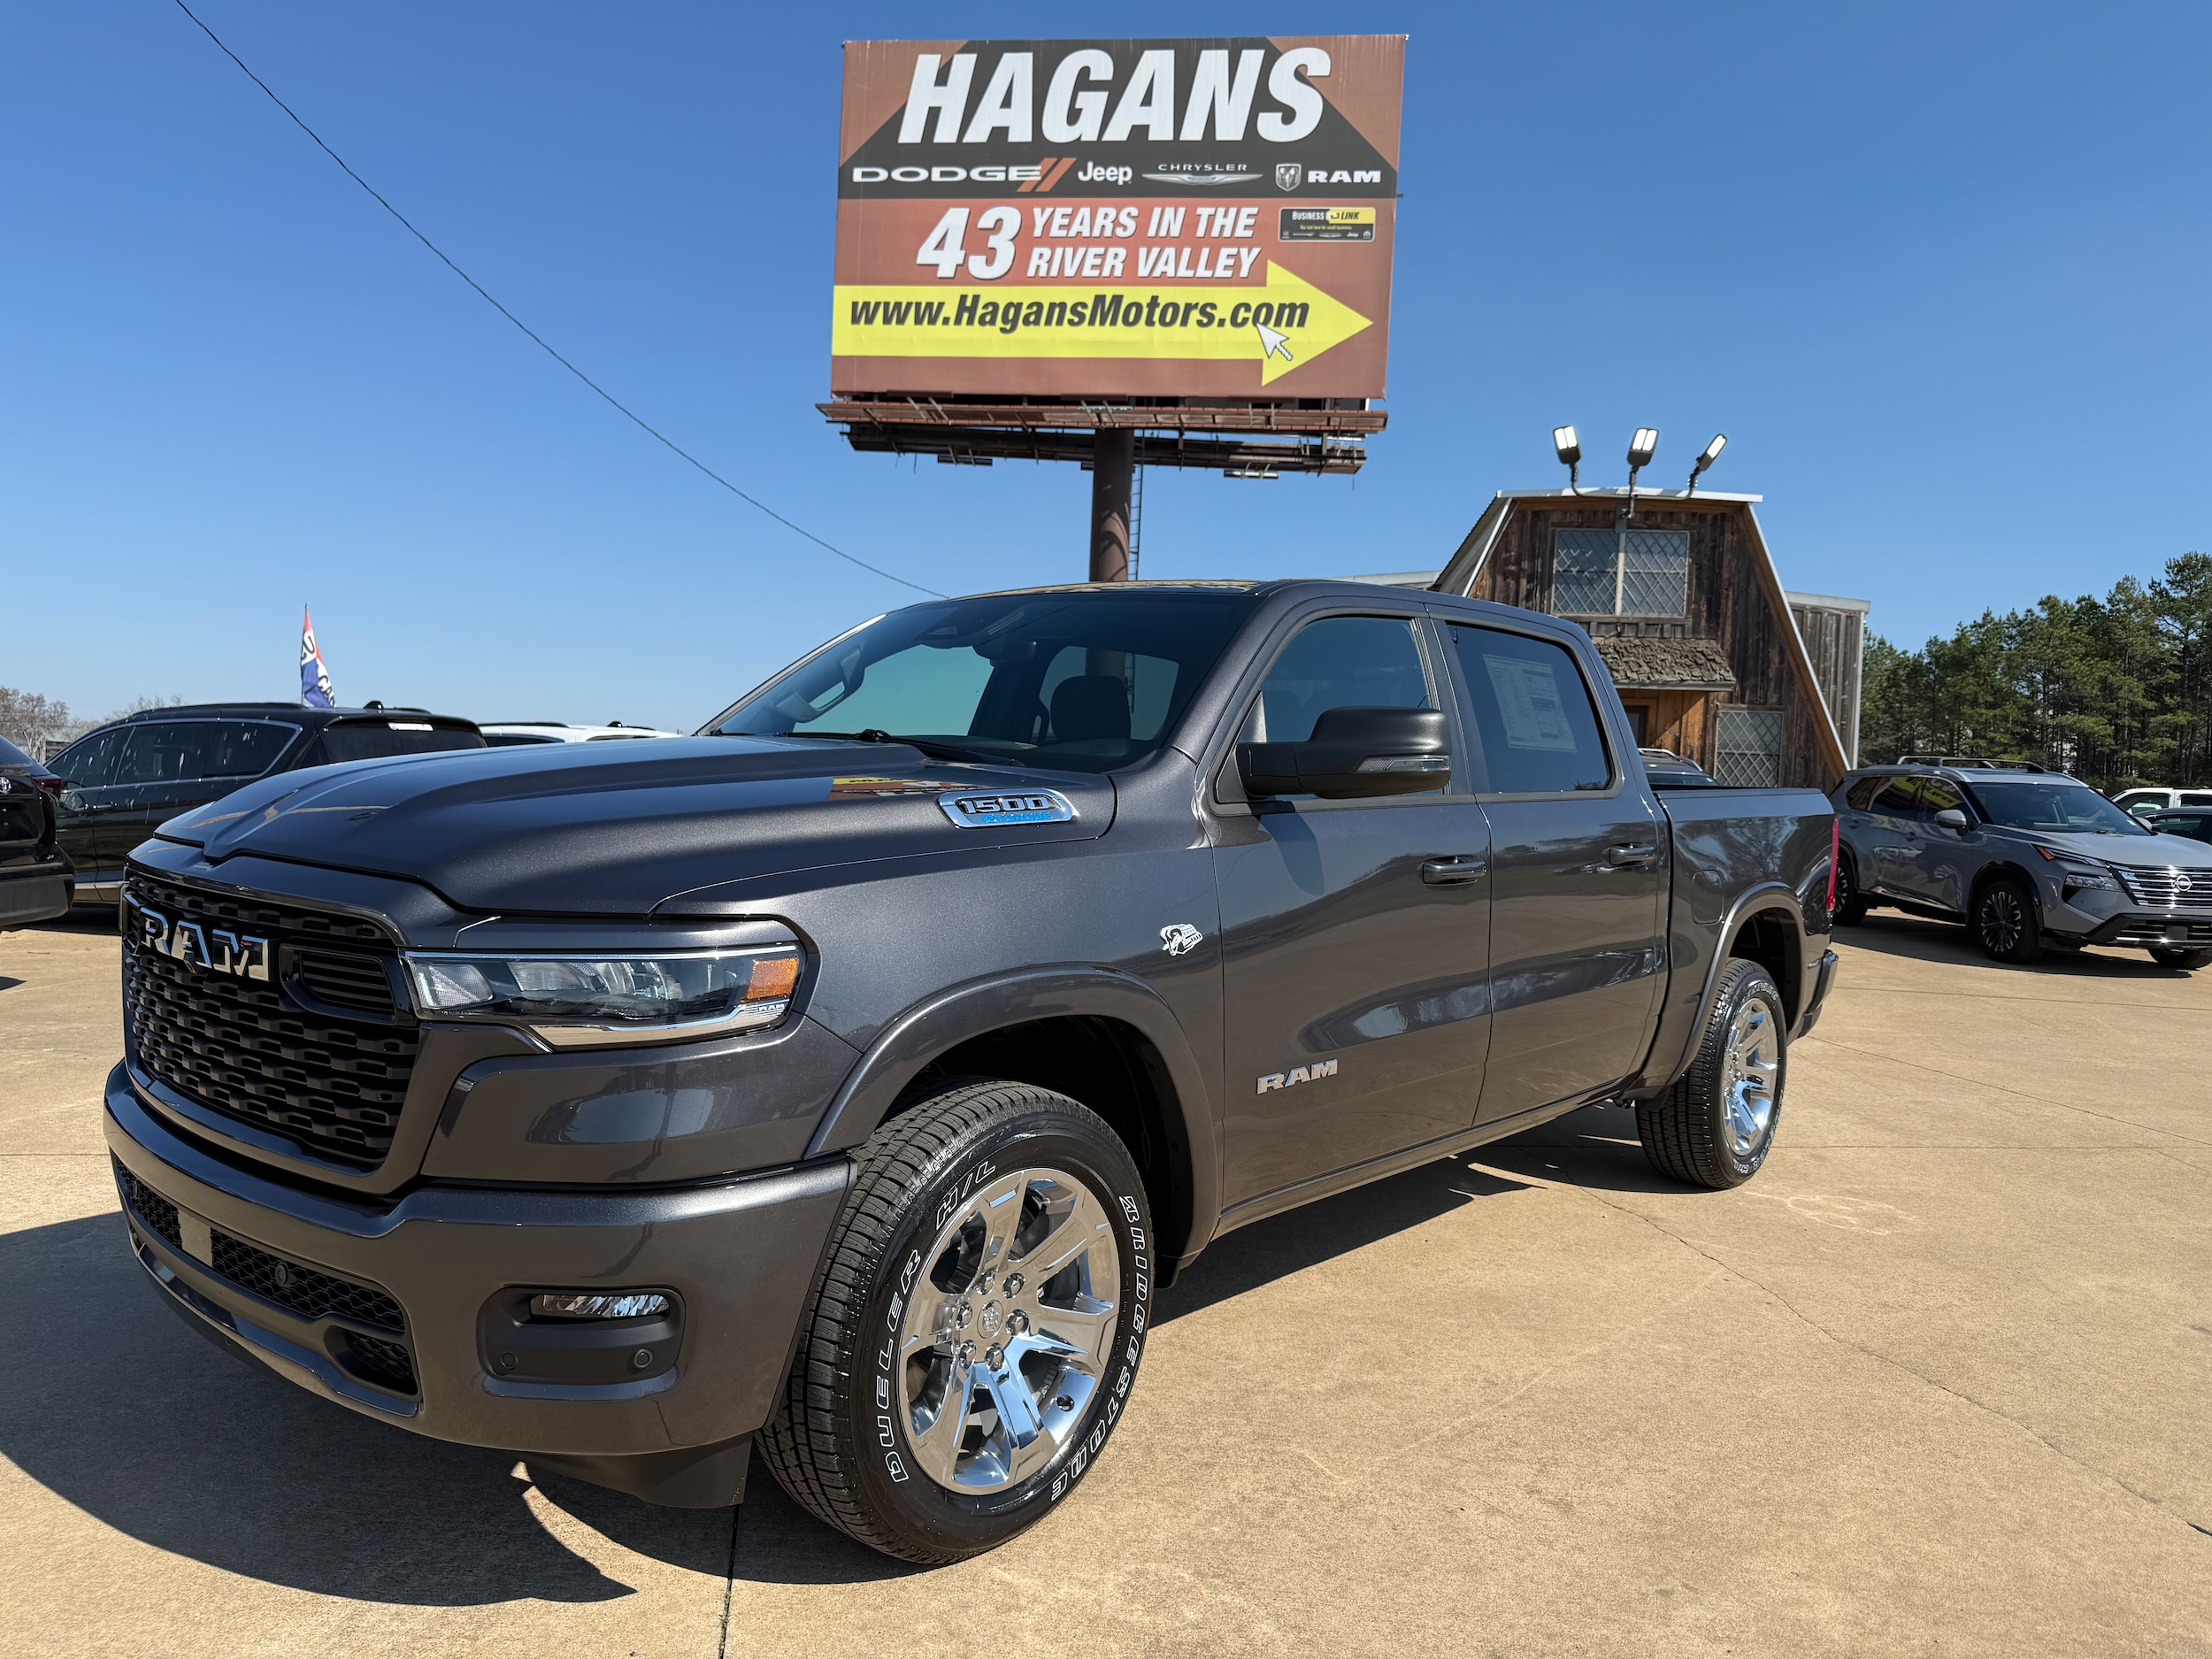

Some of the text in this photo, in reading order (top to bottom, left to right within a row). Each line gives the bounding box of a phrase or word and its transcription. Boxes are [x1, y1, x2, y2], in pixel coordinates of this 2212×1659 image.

[898, 47, 1332, 143] HAGANS
[852, 165, 1042, 182] DODGE
[1078, 161, 1133, 185] Jeep
[1157, 163, 1248, 172] CHRYSLER
[1307, 170, 1381, 183] RAM
[1032, 206, 1259, 239] YEARS IN THE
[1292, 211, 1360, 220] BUSINESS LINK
[915, 205, 1024, 280] 43
[1026, 247, 1263, 279] RIVER VALLEY
[850, 293, 1310, 334] www.HagansMotors.com
[960, 797, 1050, 815] 1500
[140, 906, 270, 982] RAM
[1256, 1058, 1339, 1094] RAM
[875, 1248, 921, 1484] DUELER
